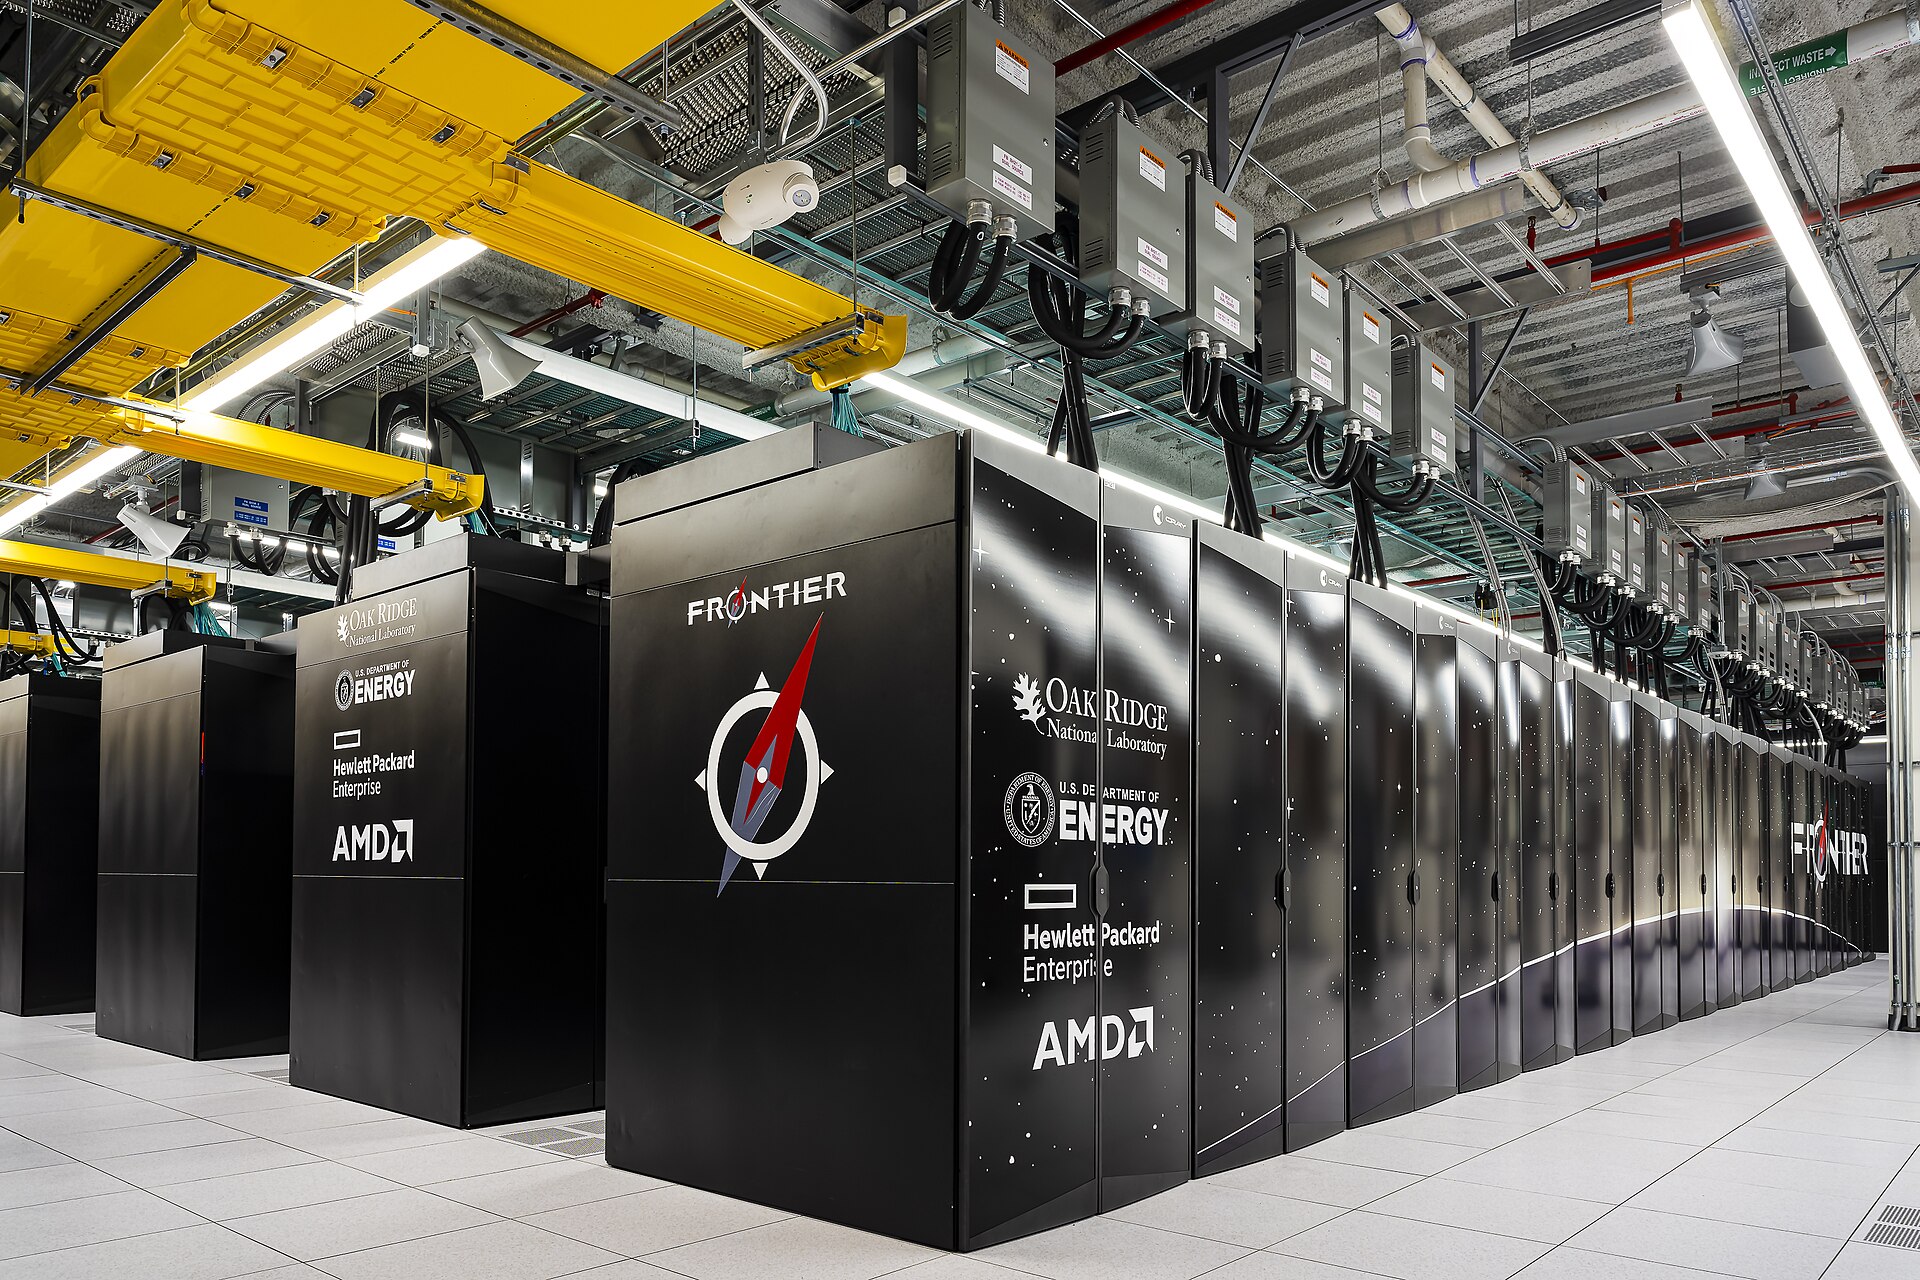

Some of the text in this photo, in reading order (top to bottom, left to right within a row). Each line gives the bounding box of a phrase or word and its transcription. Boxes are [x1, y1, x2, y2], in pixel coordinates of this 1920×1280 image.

[1792, 48, 1824, 68] WASTE
[1165, 515, 1187, 529] CRAY
[349, 597, 417, 632] OAK RIDGE
[687, 571, 847, 628] FRONTIER
[349, 624, 416, 648] National Laboratory
[354, 659, 410, 678] U.S. DEPARTMENT OF
[354, 669, 416, 705] ENERGY
[1045, 677, 1169, 732] OAK RIDGE
[1046, 717, 1168, 761] Nationa Laboratory
[333, 749, 415, 777] Hewlett Packard
[332, 777, 381, 801] Enterprise
[1059, 781, 1160, 803] U.S. DEARTMENT OF
[1059, 799, 1169, 846] ENERGY
[332, 822, 391, 862] AMD
[1023, 919, 1160, 950] Hewlett Packard
[1032, 1013, 1126, 1071] AMD
